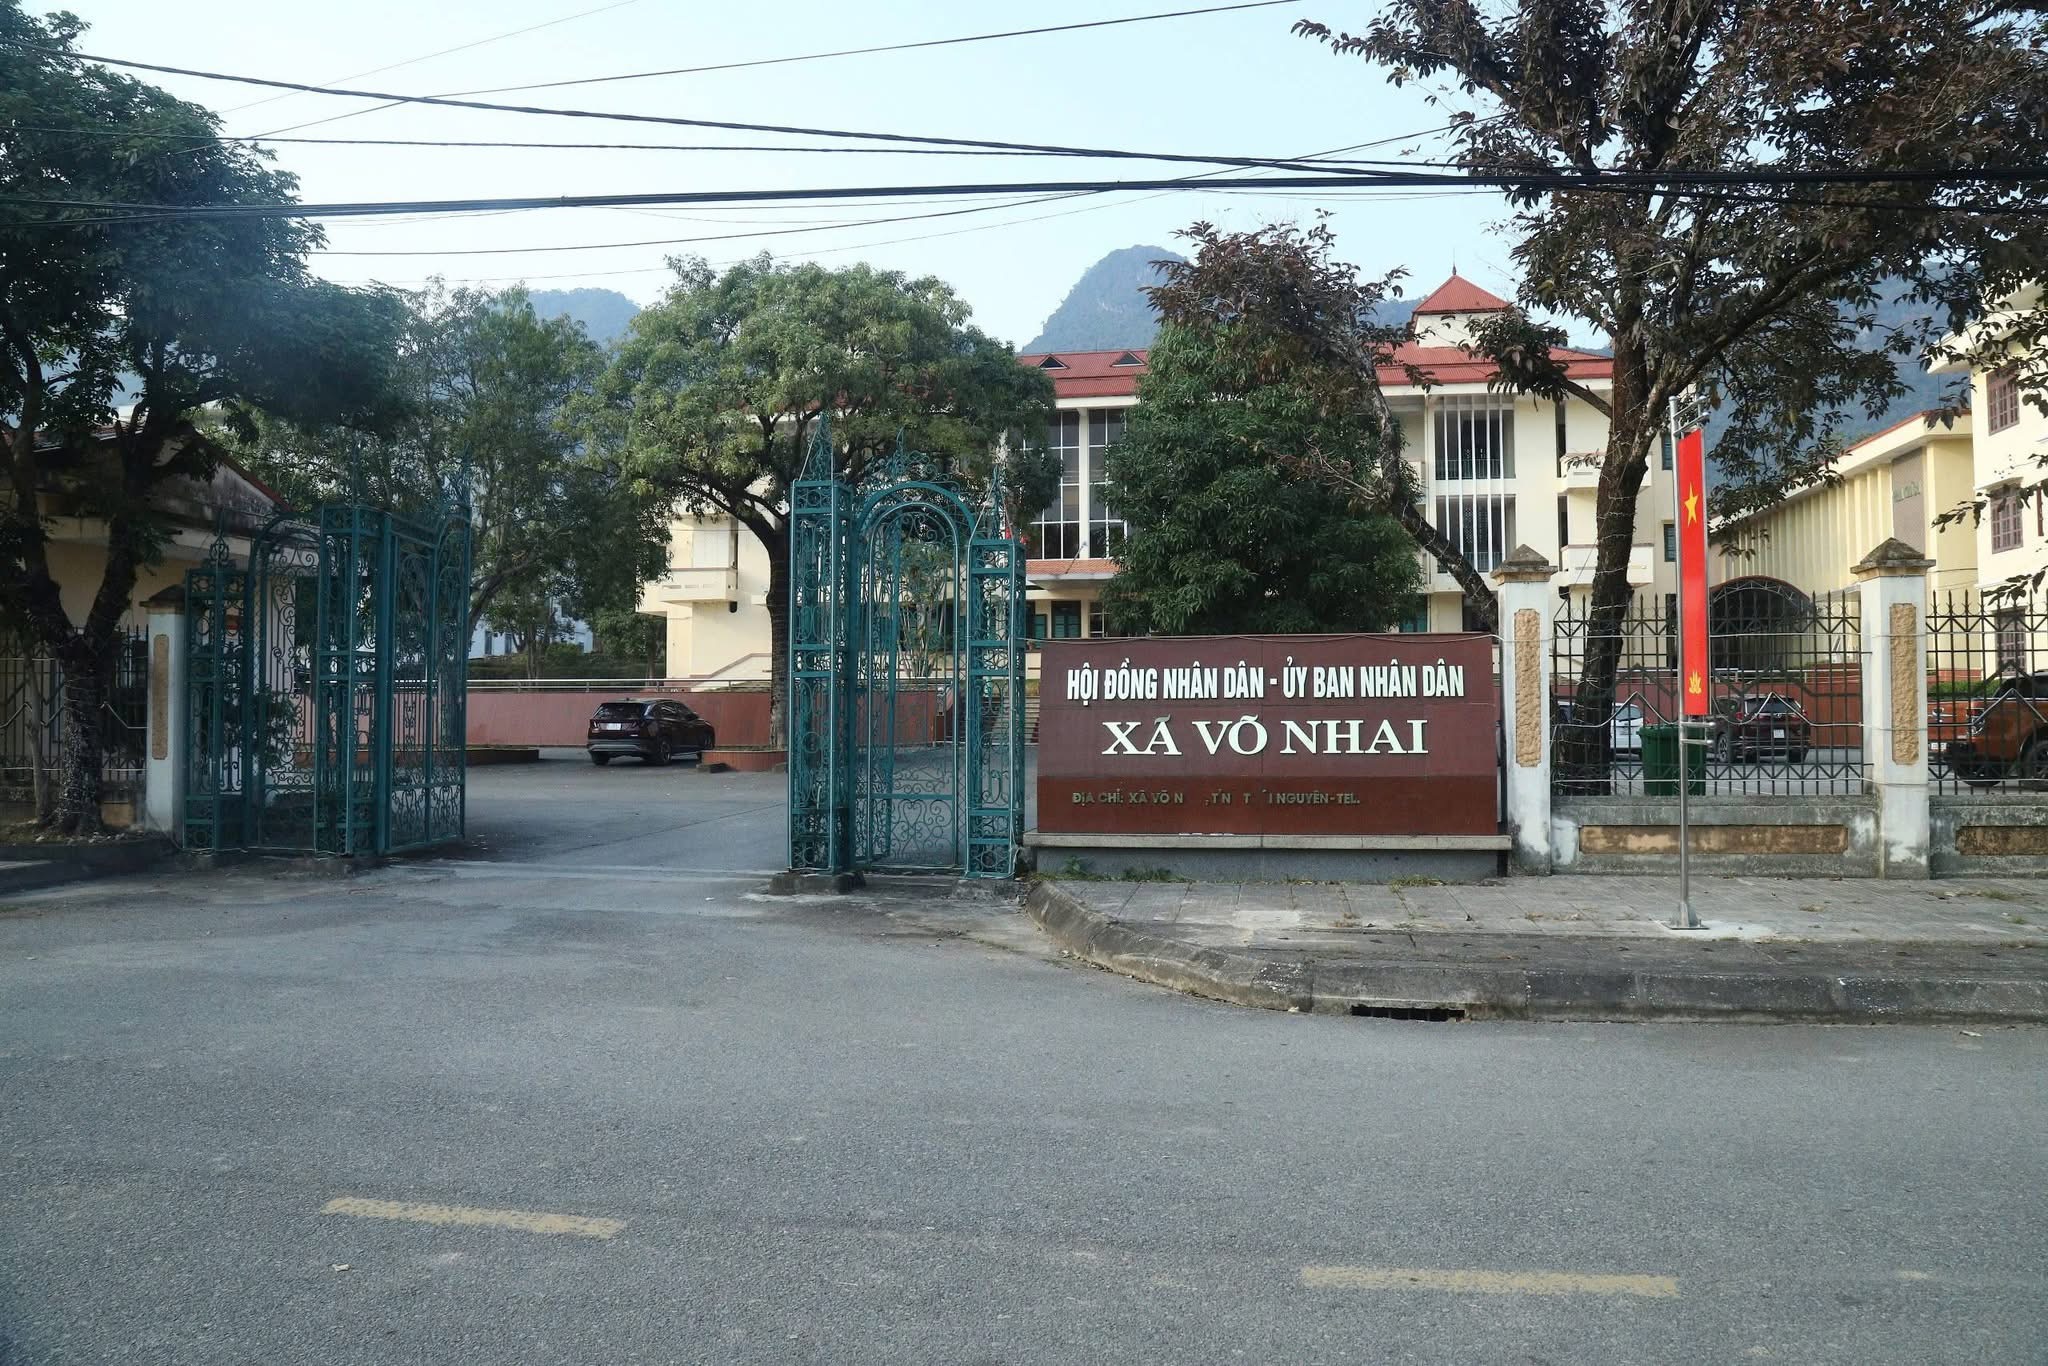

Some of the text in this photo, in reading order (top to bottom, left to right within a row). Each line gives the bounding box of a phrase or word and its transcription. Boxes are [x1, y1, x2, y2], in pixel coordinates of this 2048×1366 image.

[1067, 662, 1098, 706] HỘI
[1104, 658, 1158, 700] ĐỒNG
[1163, 661, 1217, 699] NHÂN
[1224, 661, 1264, 698] DÂN
[1283, 656, 1308, 698] ỦY
[1313, 666, 1354, 698] BAN
[1360, 659, 1417, 697] NHÂN
[1423, 658, 1464, 697] DÂN
[1102, 714, 1429, 755] XÃ VÕ NHAI
[1072, 792, 1095, 806] ĐỊA
